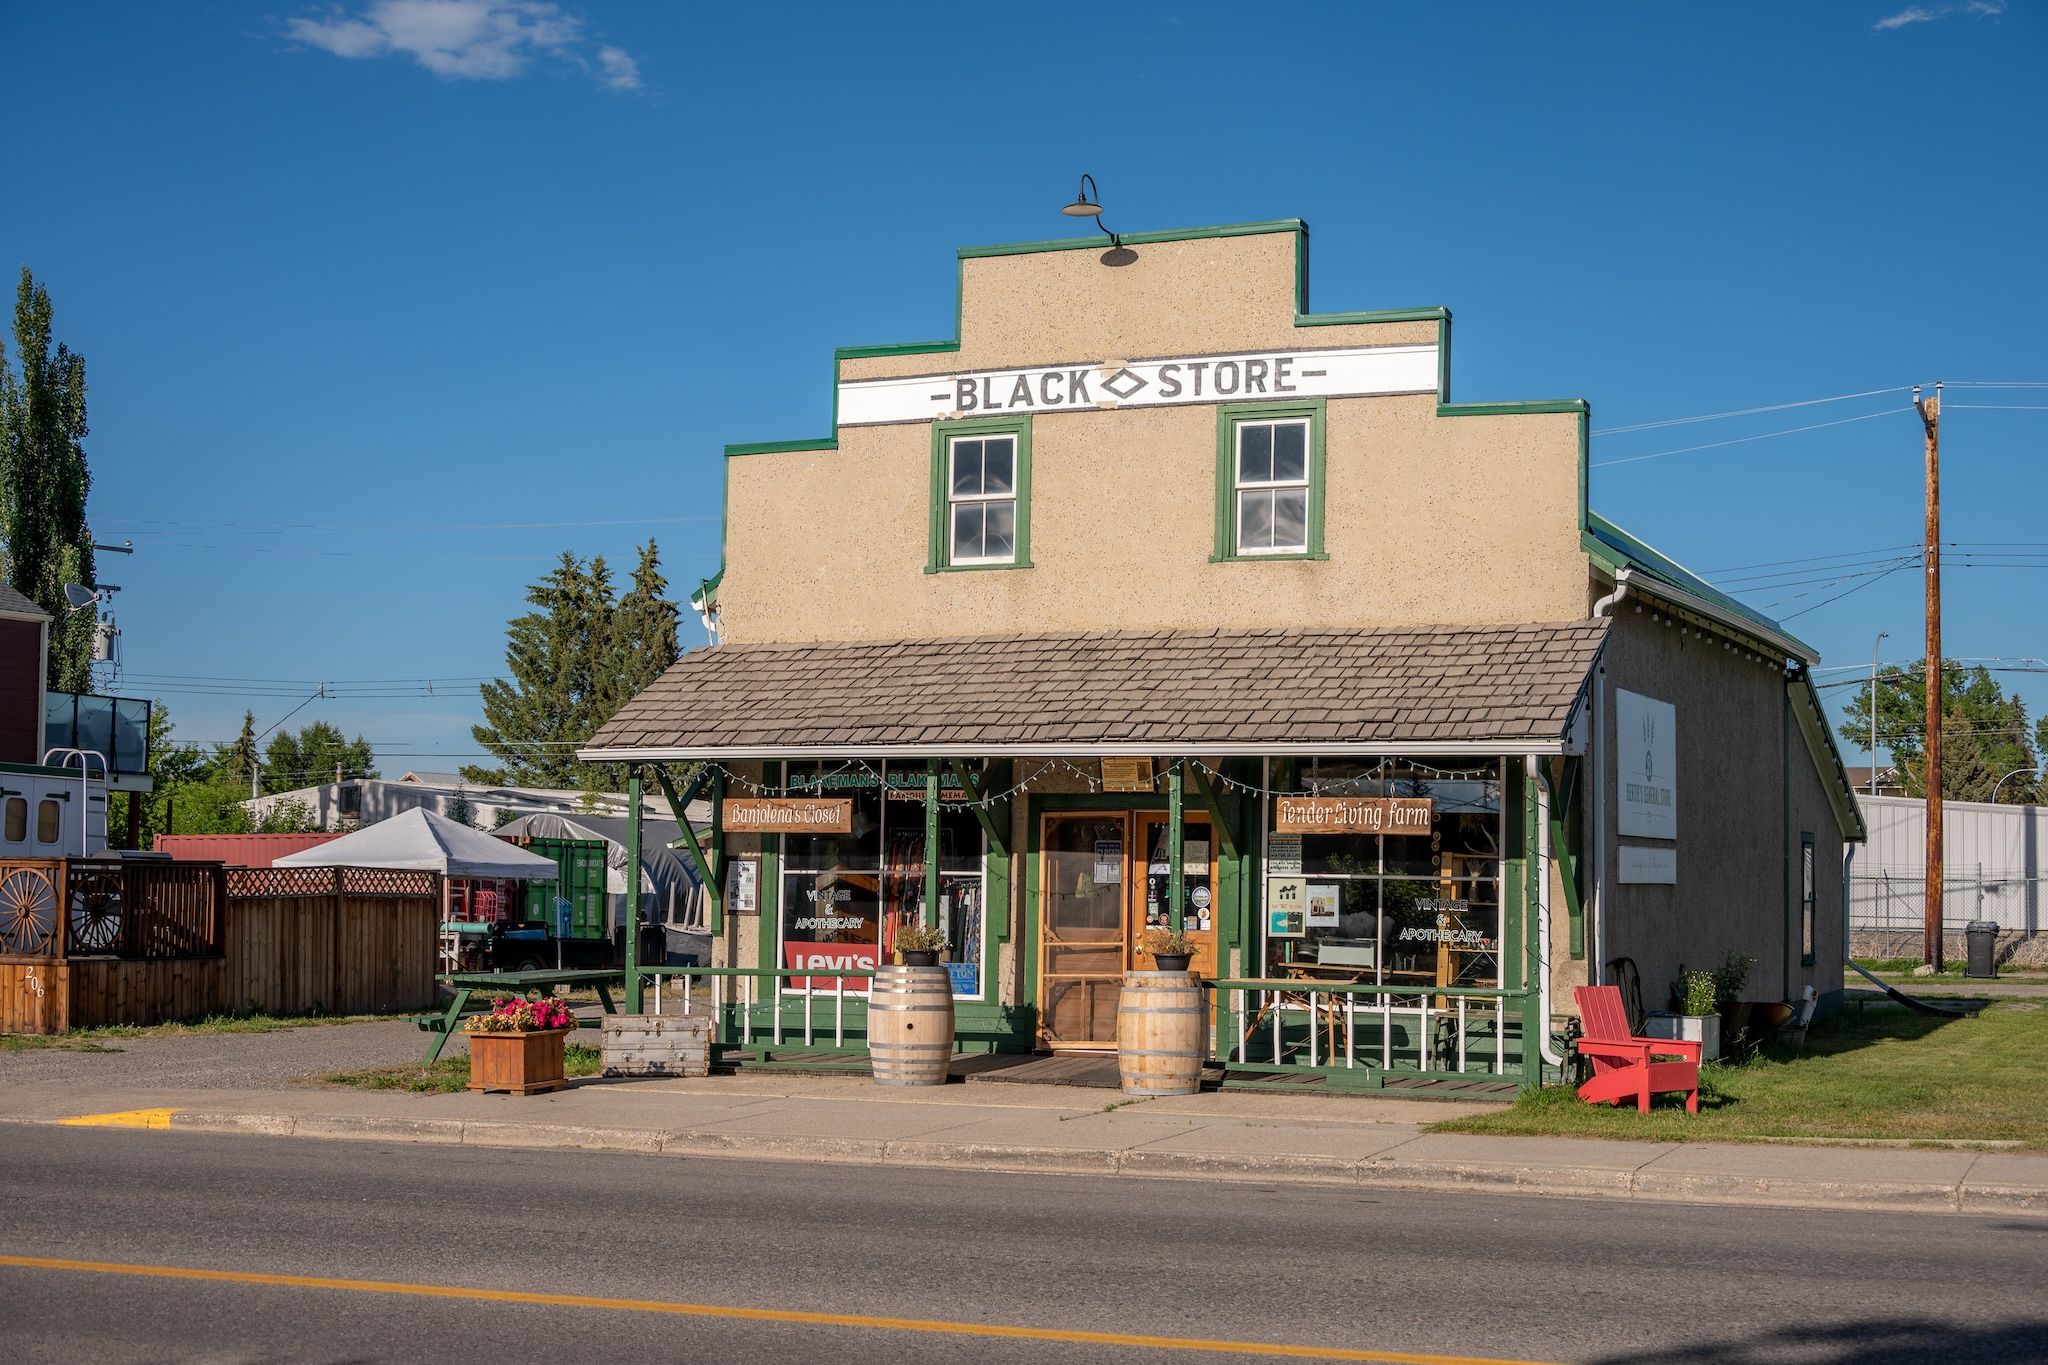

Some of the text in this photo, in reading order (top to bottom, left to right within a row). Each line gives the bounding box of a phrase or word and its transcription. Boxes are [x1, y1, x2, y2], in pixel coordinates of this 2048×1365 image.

[956, 358, 1297, 411] BLACK STORE
[790, 774, 880, 788] BLAKEMANS
[888, 773, 980, 788] BLAKMAS
[731, 803, 841, 827] Banjolena's Closet
[1279, 801, 1429, 830] Tender Living farm
[806, 889, 851, 902] VINTAGE
[824, 903, 834, 915] &
[1414, 898, 1469, 911] VINTAGE
[795, 917, 864, 929] APOTHECARY
[1435, 913, 1445, 926] &
[1399, 927, 1483, 942] APOTHECARY
[950, 969, 975, 978] ETON
[25, 966, 45, 997] 206
